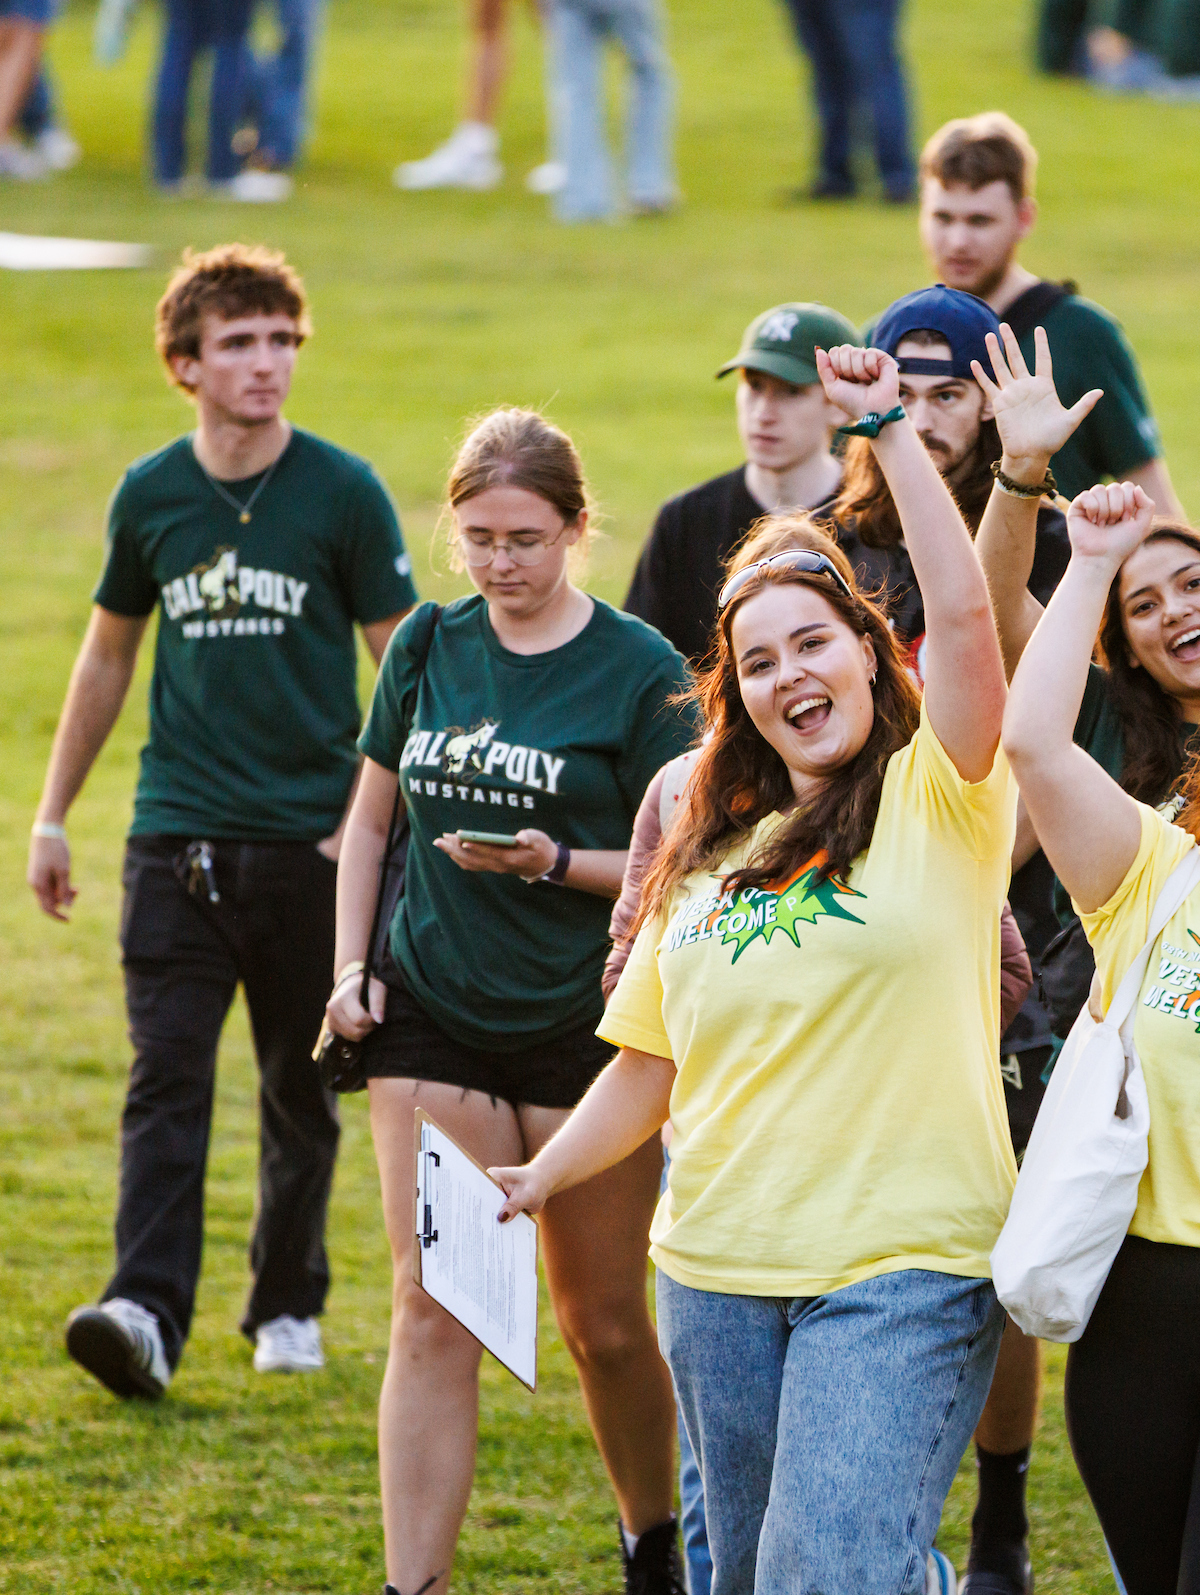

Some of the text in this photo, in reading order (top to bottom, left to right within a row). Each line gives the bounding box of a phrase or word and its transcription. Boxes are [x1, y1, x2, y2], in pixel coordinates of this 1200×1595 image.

[238, 565, 309, 617] POLY
[182, 616, 285, 639] MUSTANGS
[399, 730, 567, 795] CAL POLY
[408, 777, 535, 810] MUSTANGS
[667, 898, 778, 952] WELCOME
